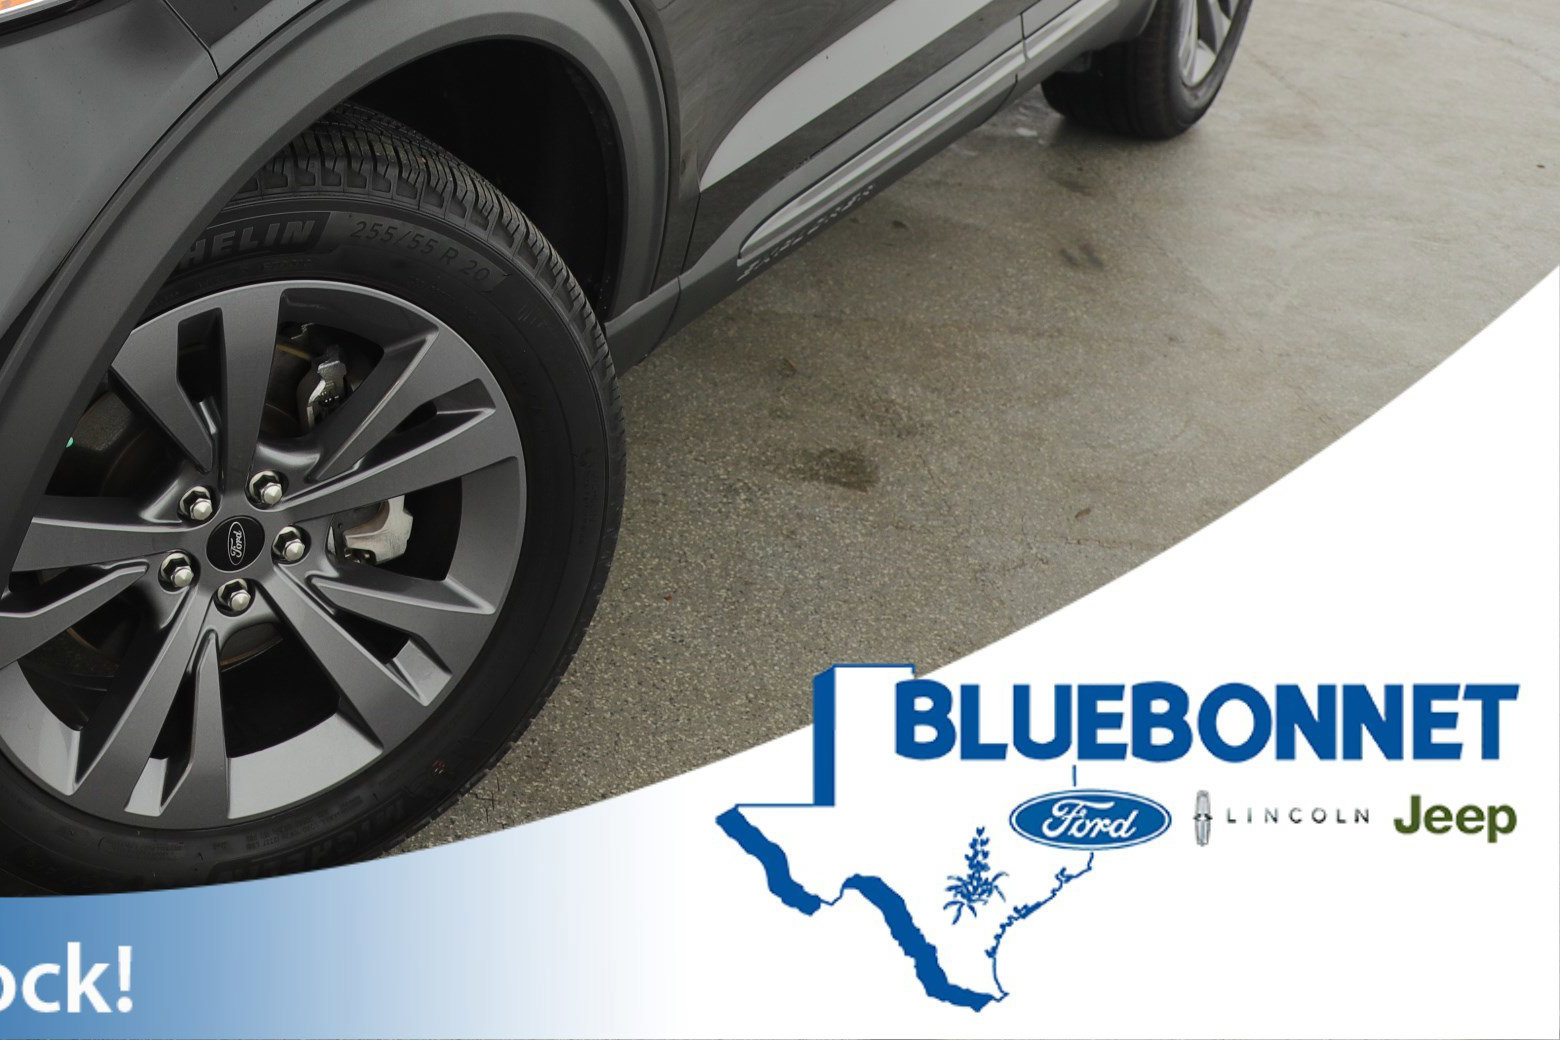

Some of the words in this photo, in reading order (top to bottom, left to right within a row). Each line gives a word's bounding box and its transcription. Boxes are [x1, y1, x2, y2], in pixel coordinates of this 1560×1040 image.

[349, 220, 439, 256] 255/55
[439, 247, 459, 266] R
[460, 259, 491, 282] 20
[230, 530, 244, 558] Ford
